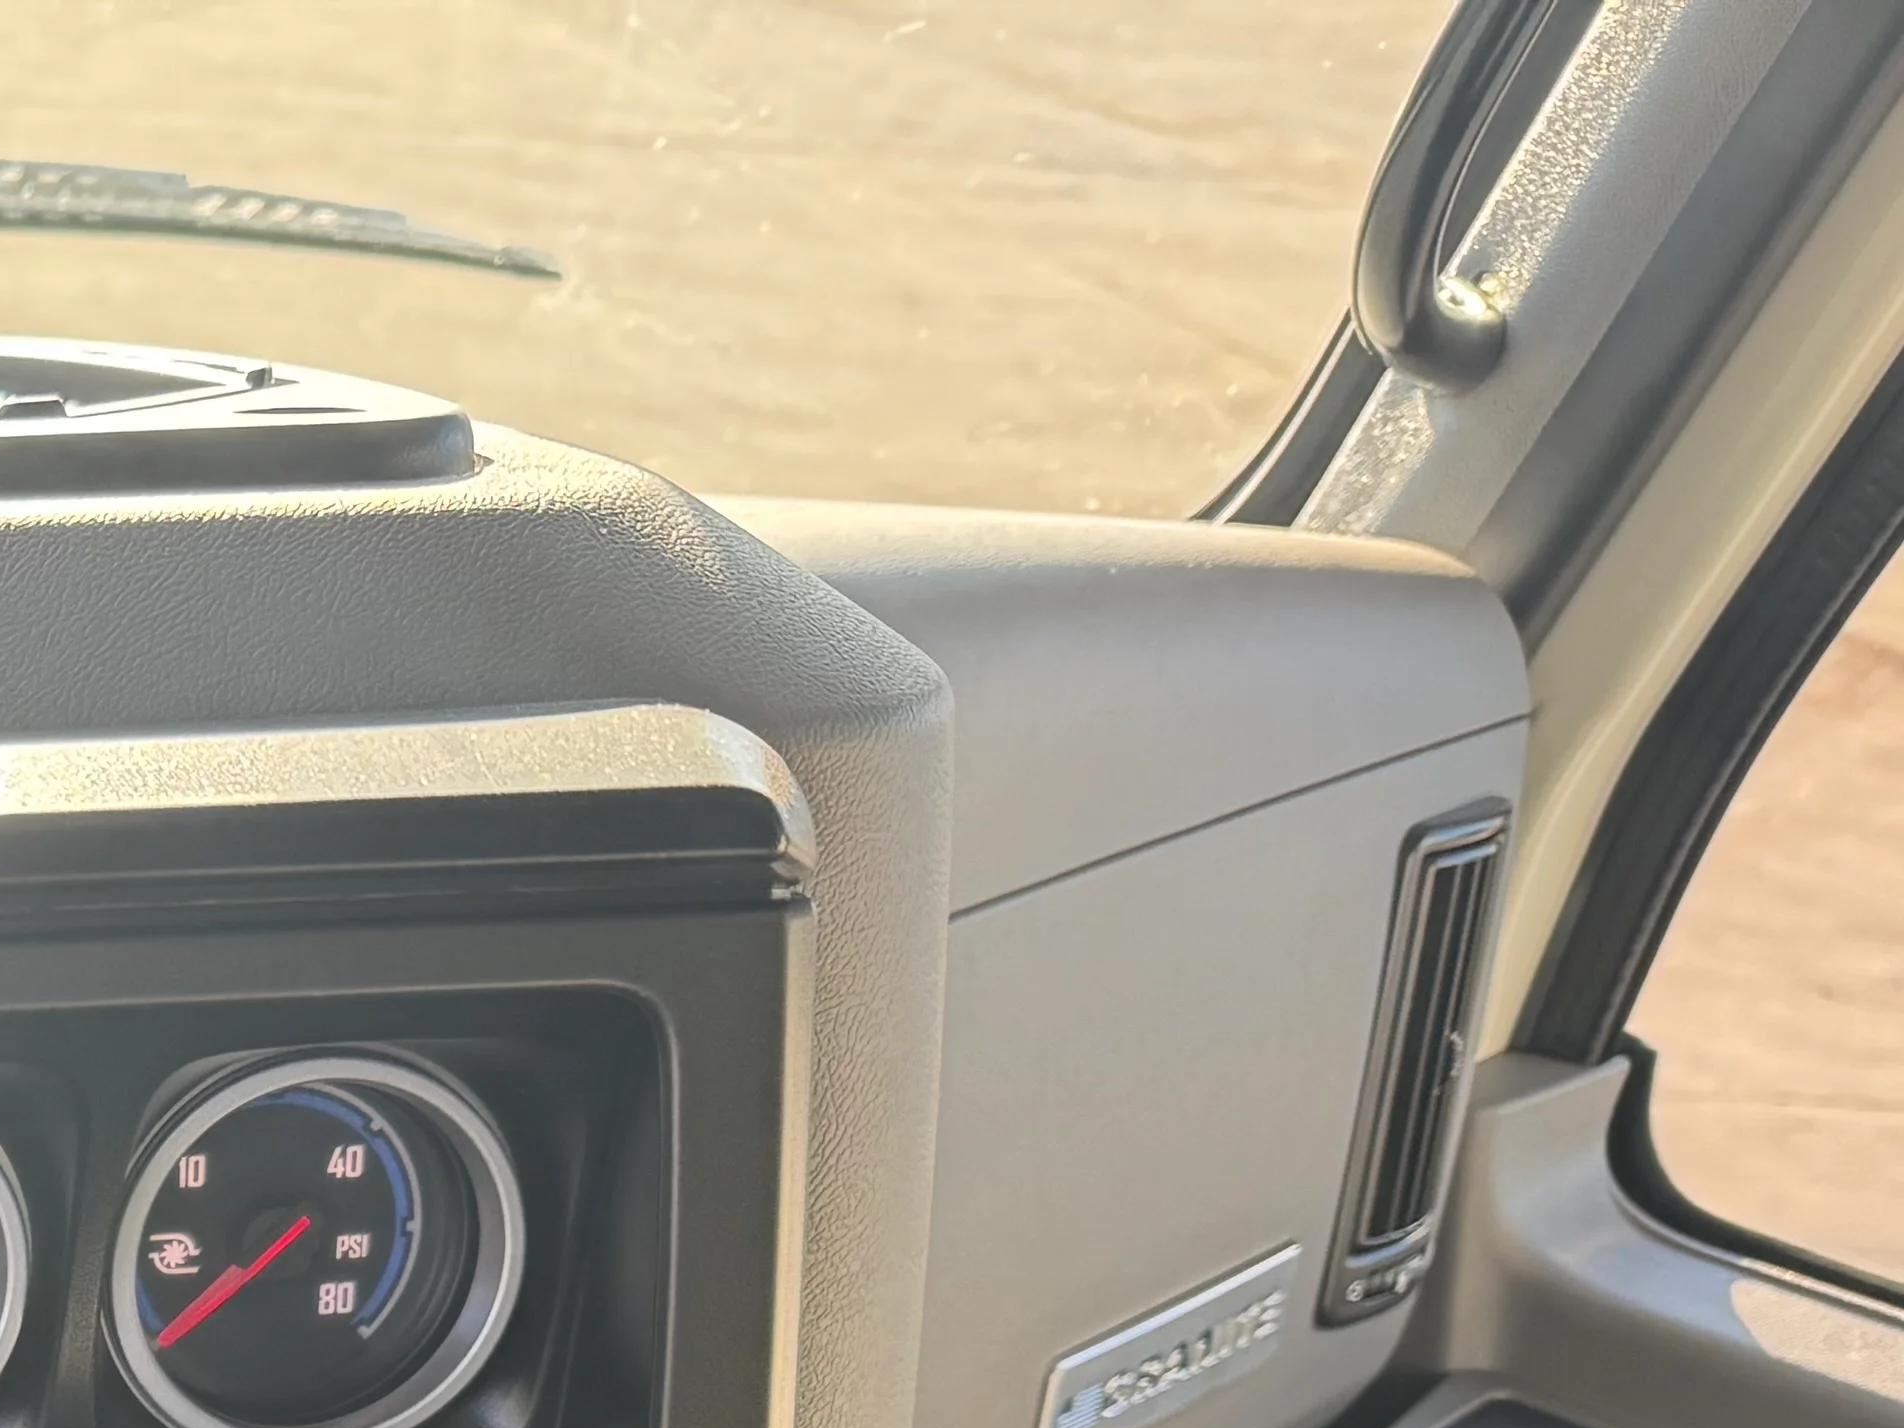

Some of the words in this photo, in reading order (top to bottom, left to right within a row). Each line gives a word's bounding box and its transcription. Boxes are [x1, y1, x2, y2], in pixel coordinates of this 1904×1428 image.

[178, 1154, 206, 1188] 10
[326, 1144, 365, 1179] 40
[335, 1233, 370, 1260] PSI
[317, 1282, 356, 1315] 80
